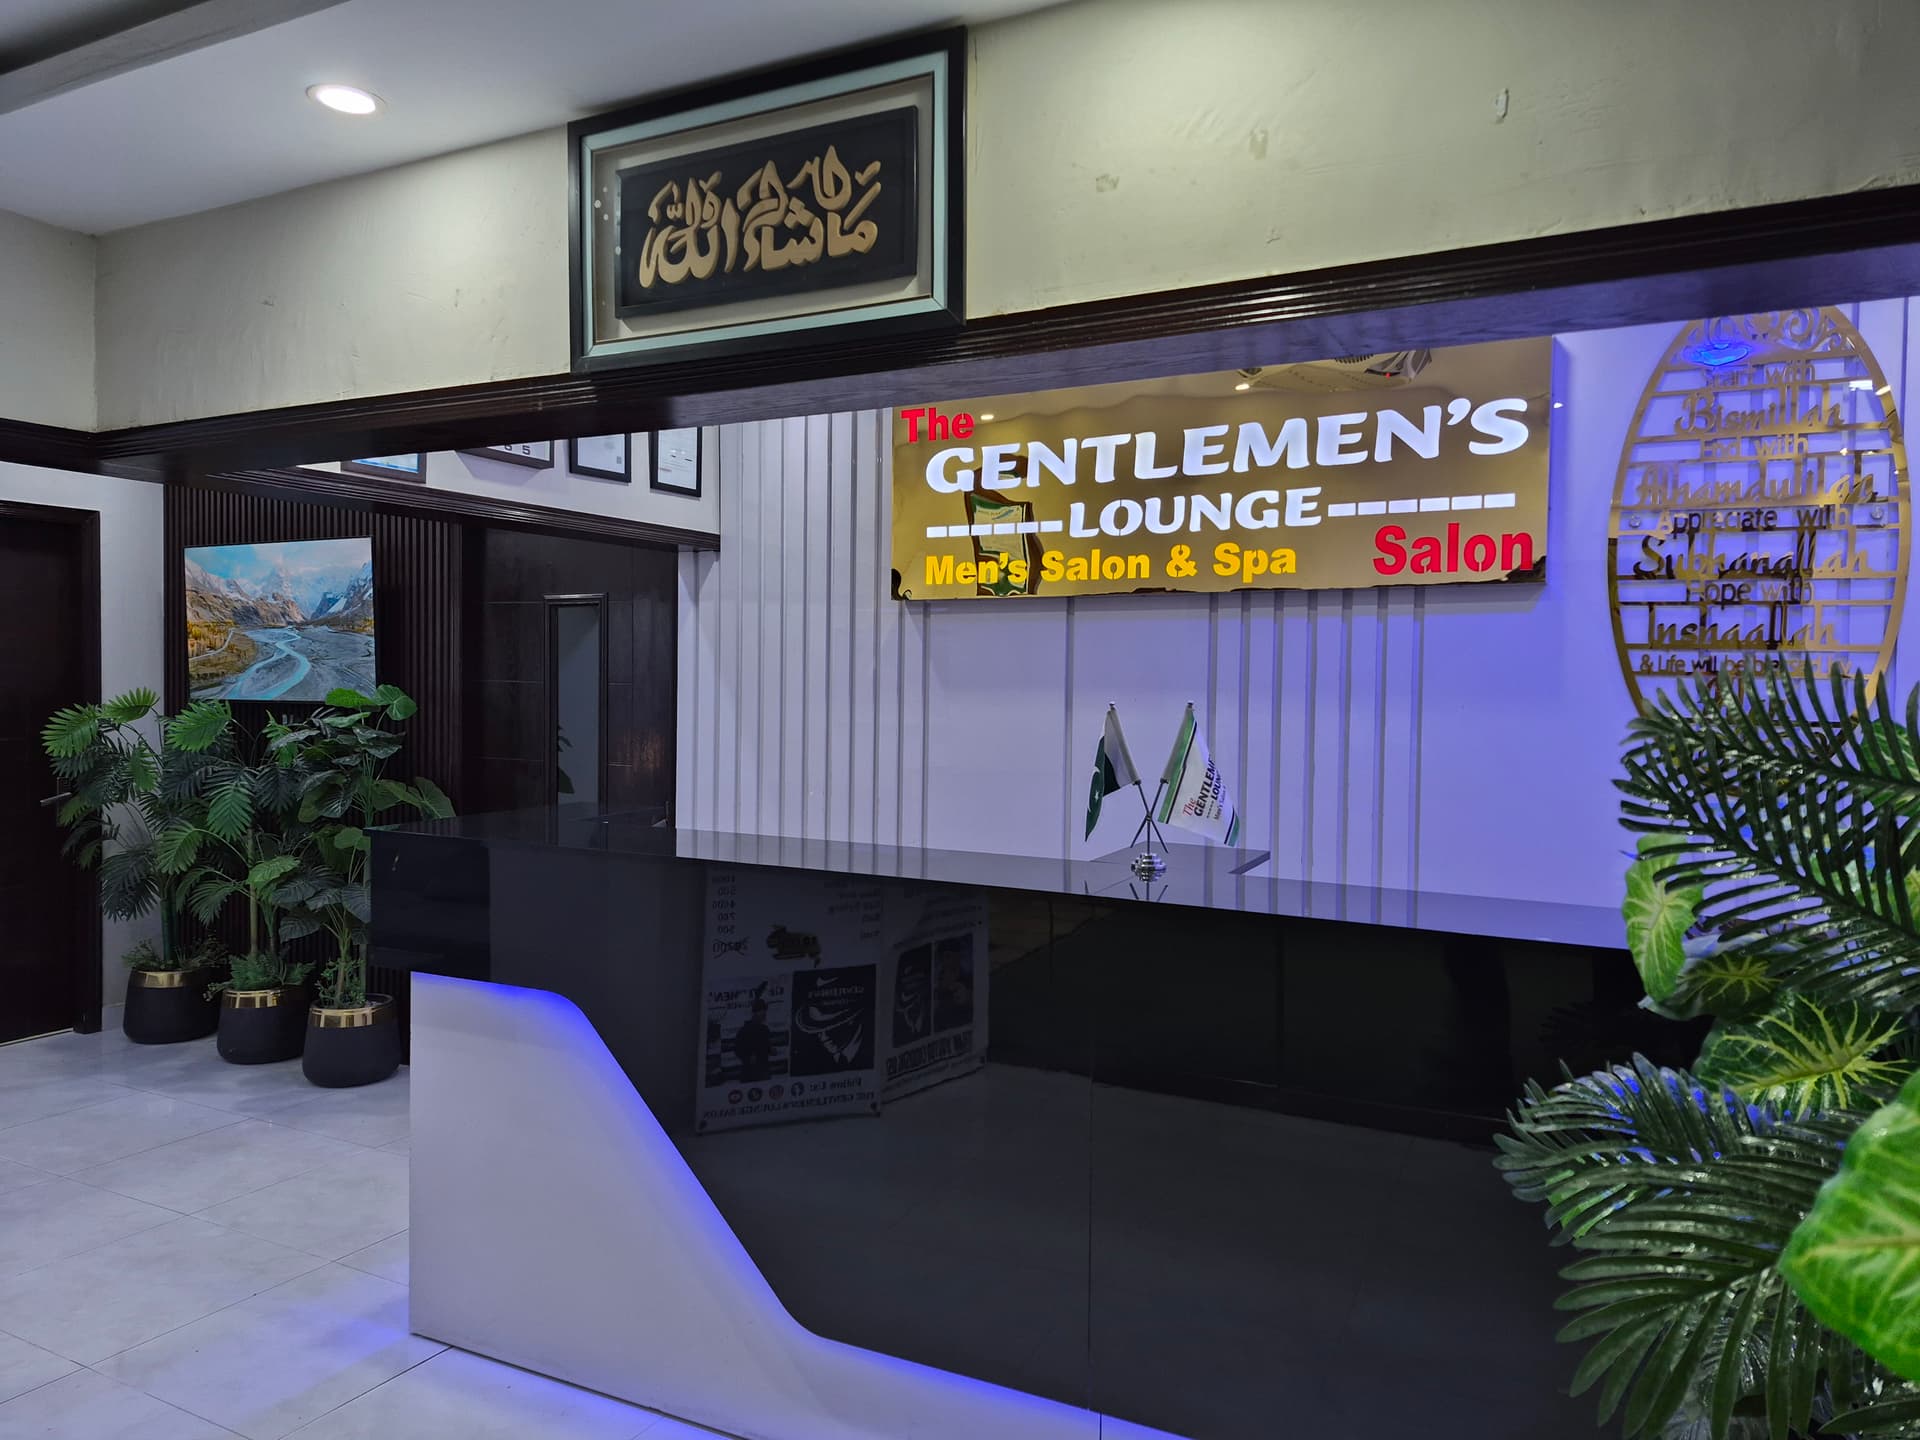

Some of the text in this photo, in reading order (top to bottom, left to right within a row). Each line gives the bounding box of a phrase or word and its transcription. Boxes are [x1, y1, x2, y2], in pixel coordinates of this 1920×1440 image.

[1765, 360, 1816, 385] with
[901, 408, 974, 442] The
[1674, 384, 1845, 434] Bismillah
[926, 398, 1529, 493] GENTLEMEN'S
[1701, 434, 1809, 459] End with
[1067, 486, 1322, 538] LOUNGE
[1657, 505, 1850, 539] Appreciate with
[925, 541, 1297, 585] Men's Salon & Spa
[1372, 522, 1534, 577] Salon
[1686, 578, 1815, 610] Hope with
[1640, 655, 1655, 673] &
[1657, 655, 1686, 672] Life
[1691, 655, 1718, 673] will
[1724, 654, 1745, 673] be
[1183, 797, 1197, 816] The
